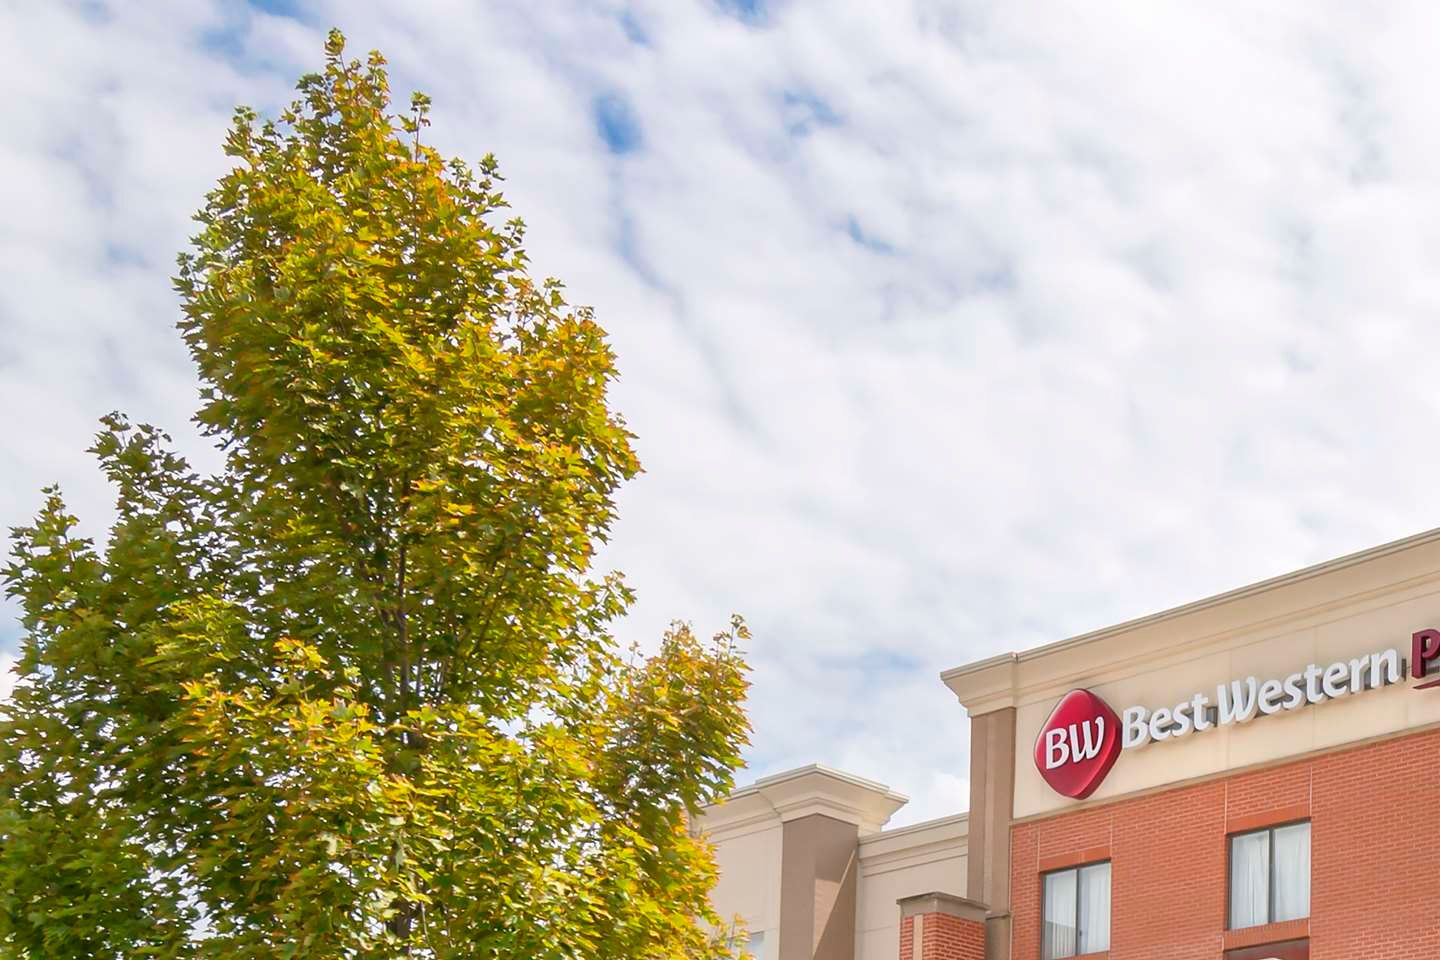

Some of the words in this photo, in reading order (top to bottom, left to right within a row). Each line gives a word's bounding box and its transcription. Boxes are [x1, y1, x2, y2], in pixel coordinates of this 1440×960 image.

[1122, 693, 1211, 749] Best
[1217, 648, 1400, 725] Western
[1045, 716, 1105, 769] BW
